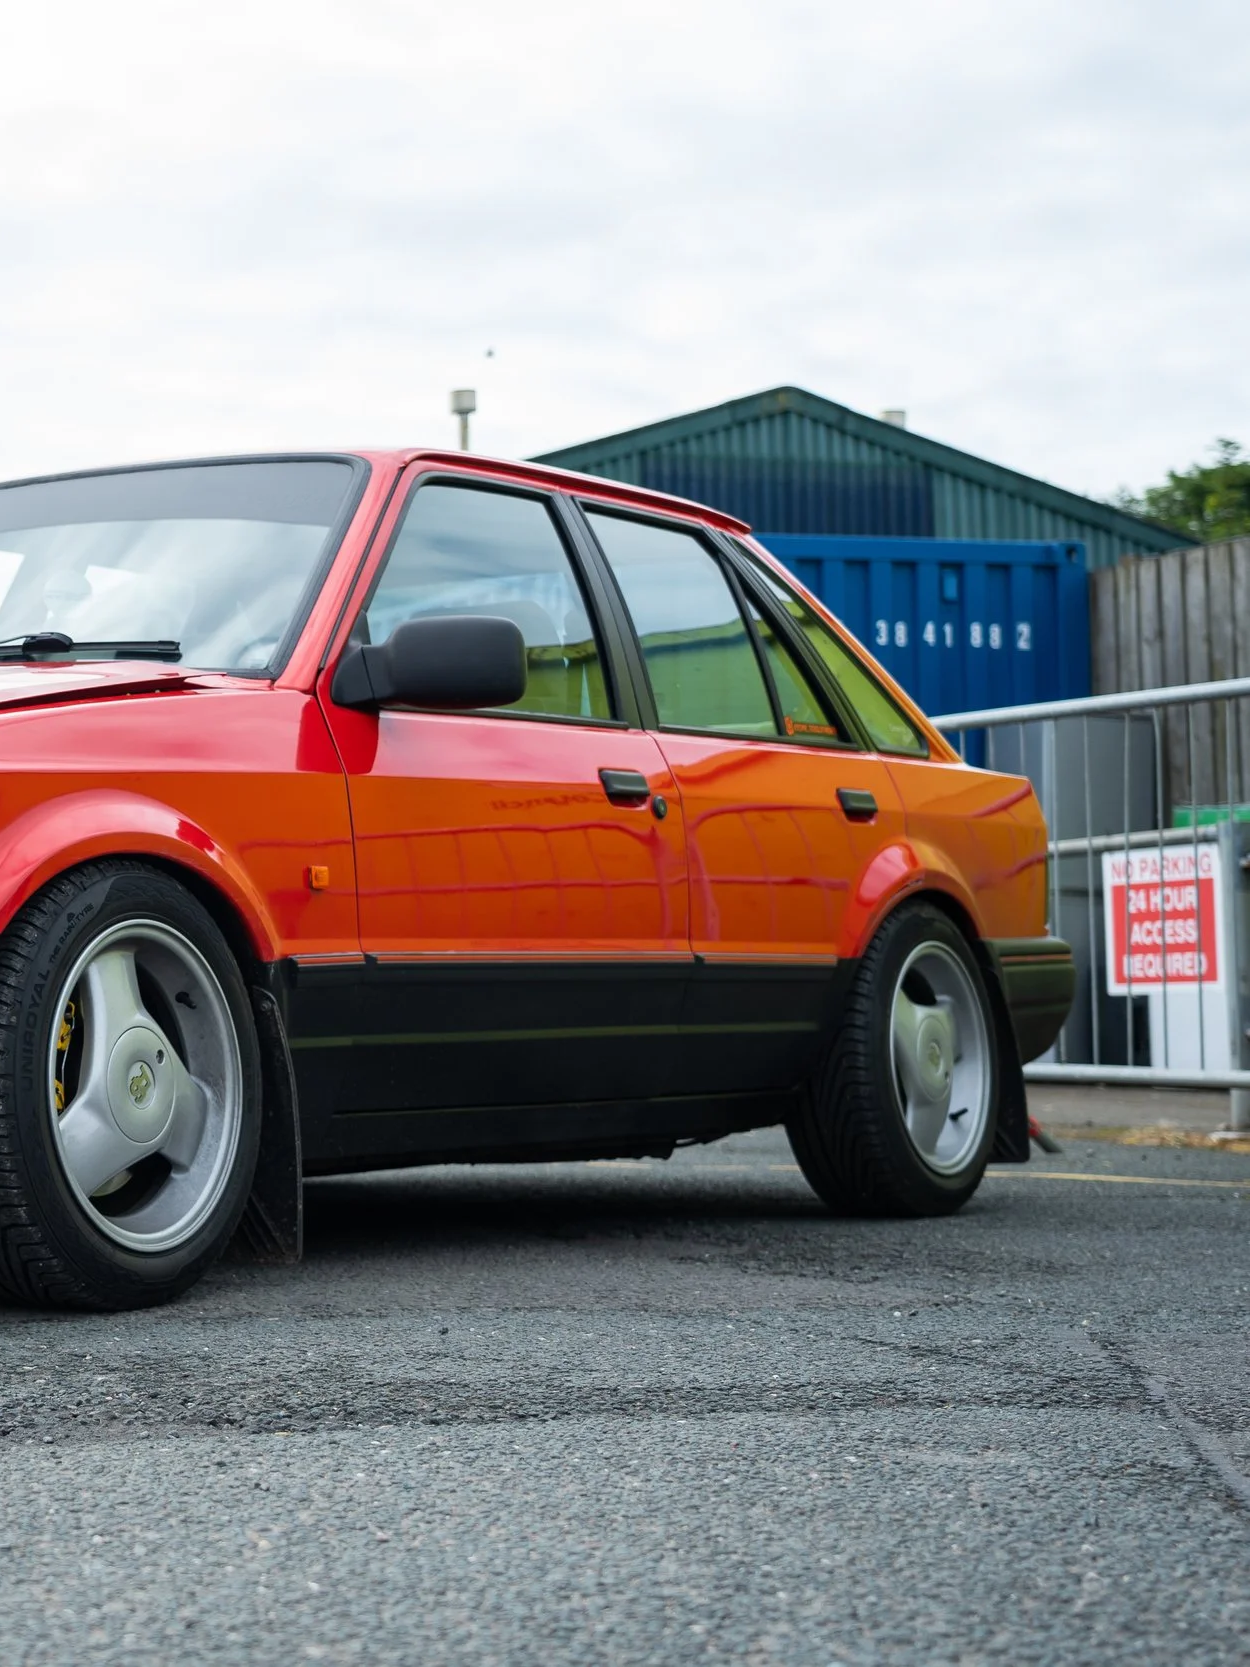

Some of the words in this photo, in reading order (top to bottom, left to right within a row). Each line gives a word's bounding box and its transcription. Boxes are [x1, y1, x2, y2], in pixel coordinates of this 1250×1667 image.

[1111, 859, 1134, 881] NO
[1139, 852, 1212, 877] PARKING
[1128, 888, 1147, 913] 24
[1149, 885, 1198, 912] HOUR
[1130, 918, 1198, 945] ACCESS
[21, 969, 50, 1091] UNIROYAL
